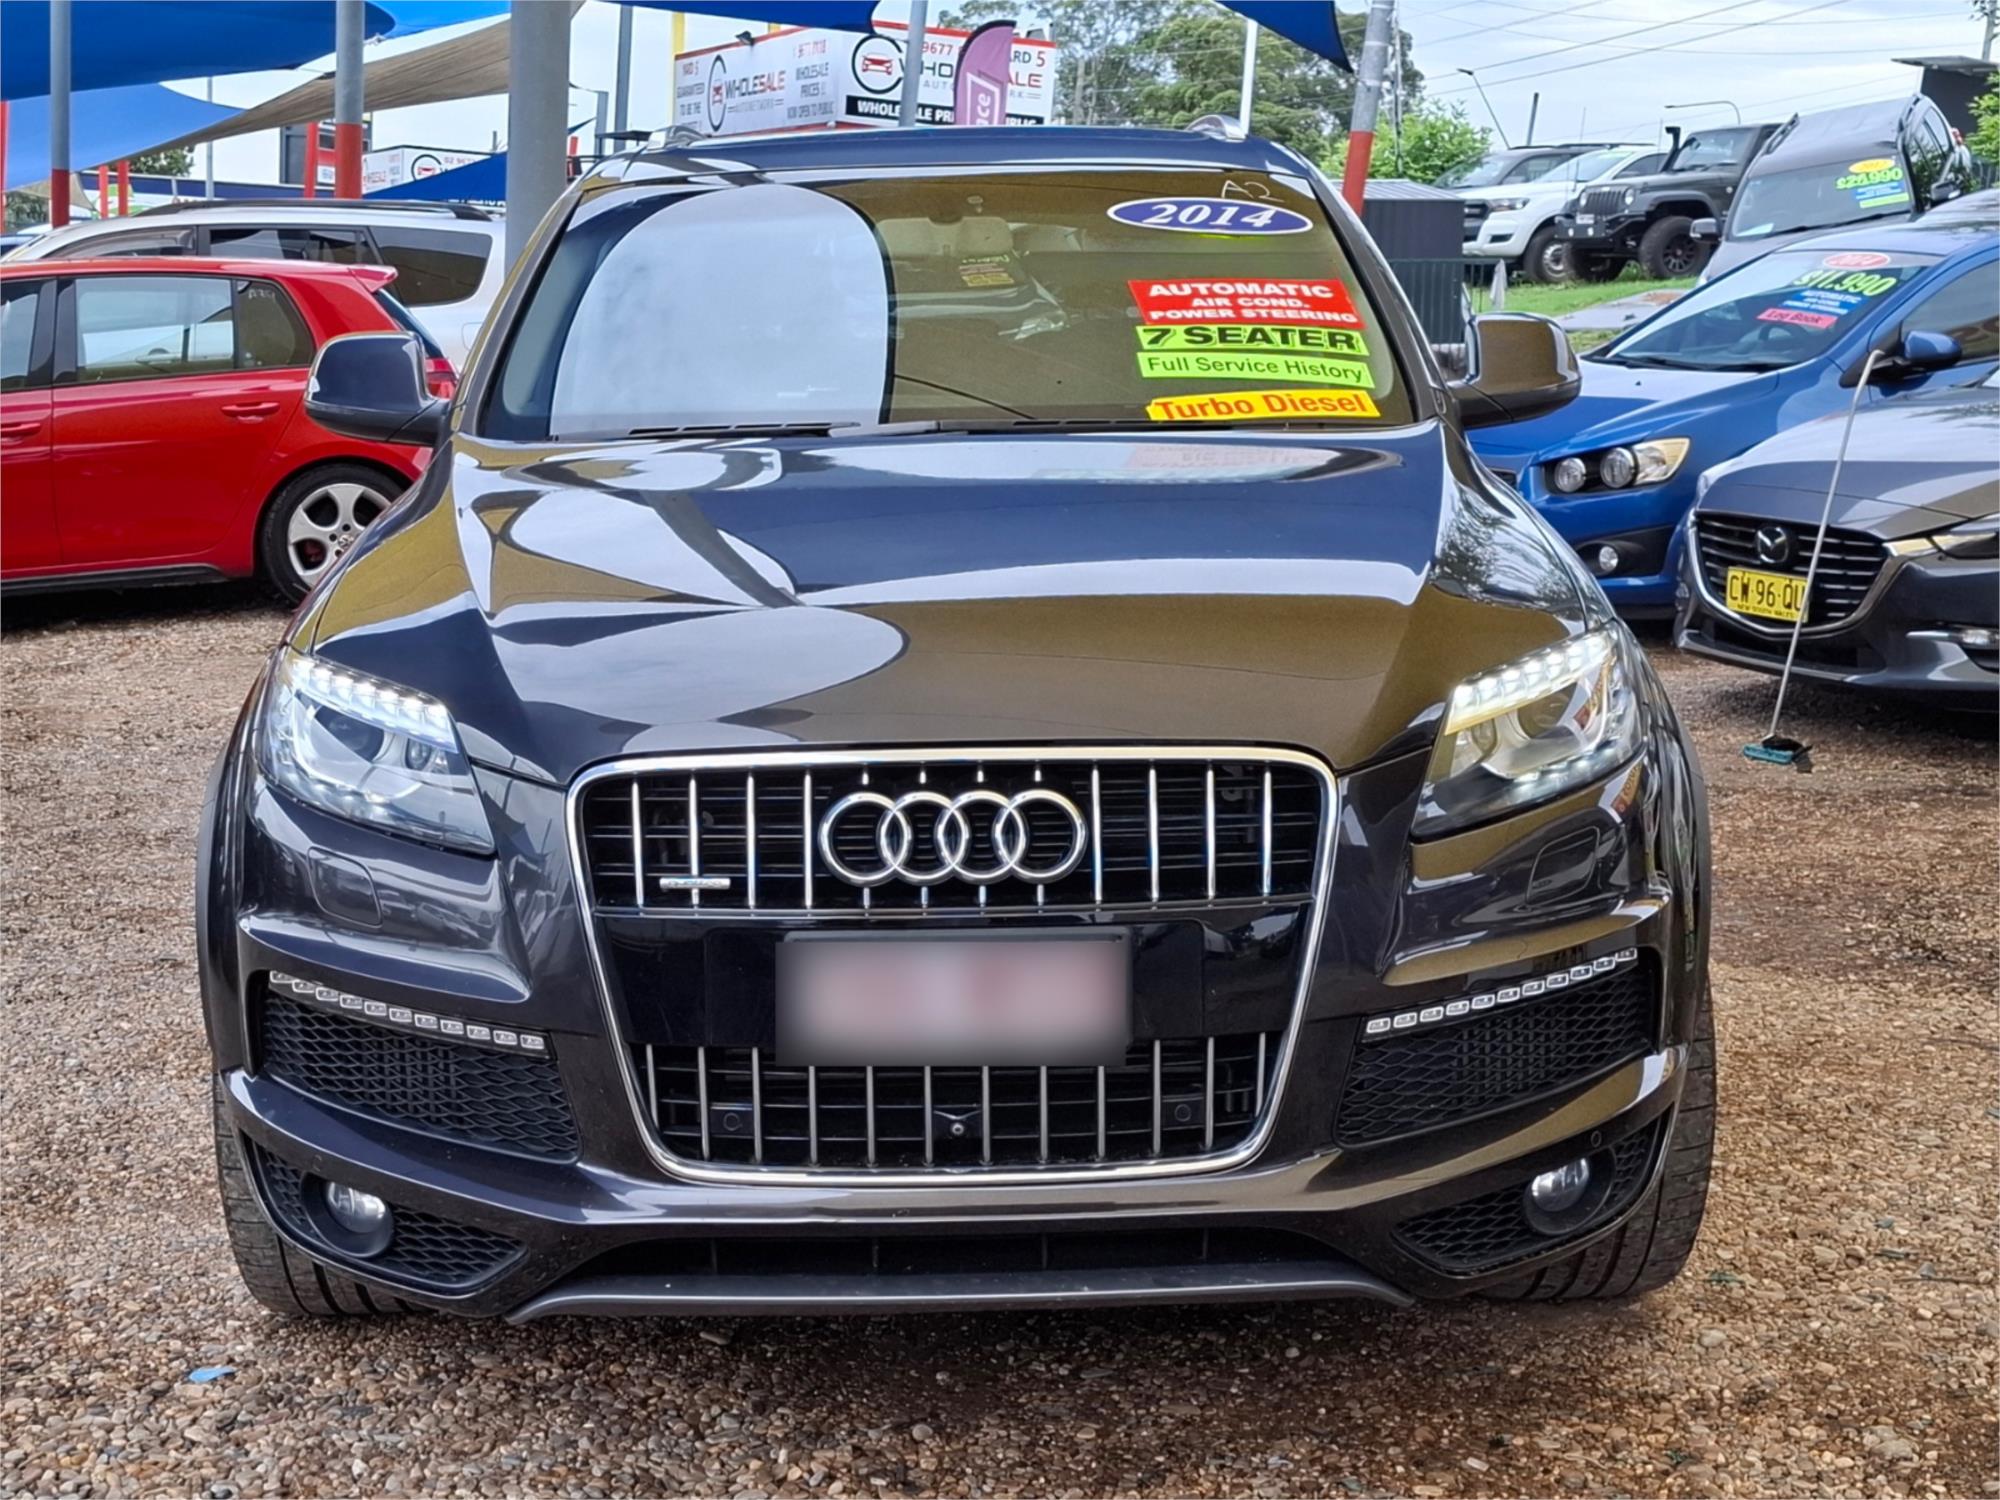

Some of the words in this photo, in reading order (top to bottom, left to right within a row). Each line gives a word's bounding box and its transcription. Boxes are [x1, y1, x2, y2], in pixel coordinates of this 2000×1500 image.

[1036, 51, 1045, 67] 5
[725, 71, 787, 99] WHOLESALE
[1142, 203, 1278, 227] 2014
[1149, 282, 1334, 298] AUTOMATIC
[1191, 297, 1234, 307] AIR
[1238, 297, 1310, 308] COND.
[1151, 309, 1235, 320] POWER
[1241, 308, 1358, 323] STEERING
[1143, 328, 1175, 347] 7
[1184, 327, 1358, 350] SEATER
[1148, 357, 1189, 372] Full
[1196, 358, 1279, 374] Service
[1287, 361, 1362, 383] History
[1155, 397, 1255, 419] Turbo
[1263, 393, 1368, 413] Diesel
